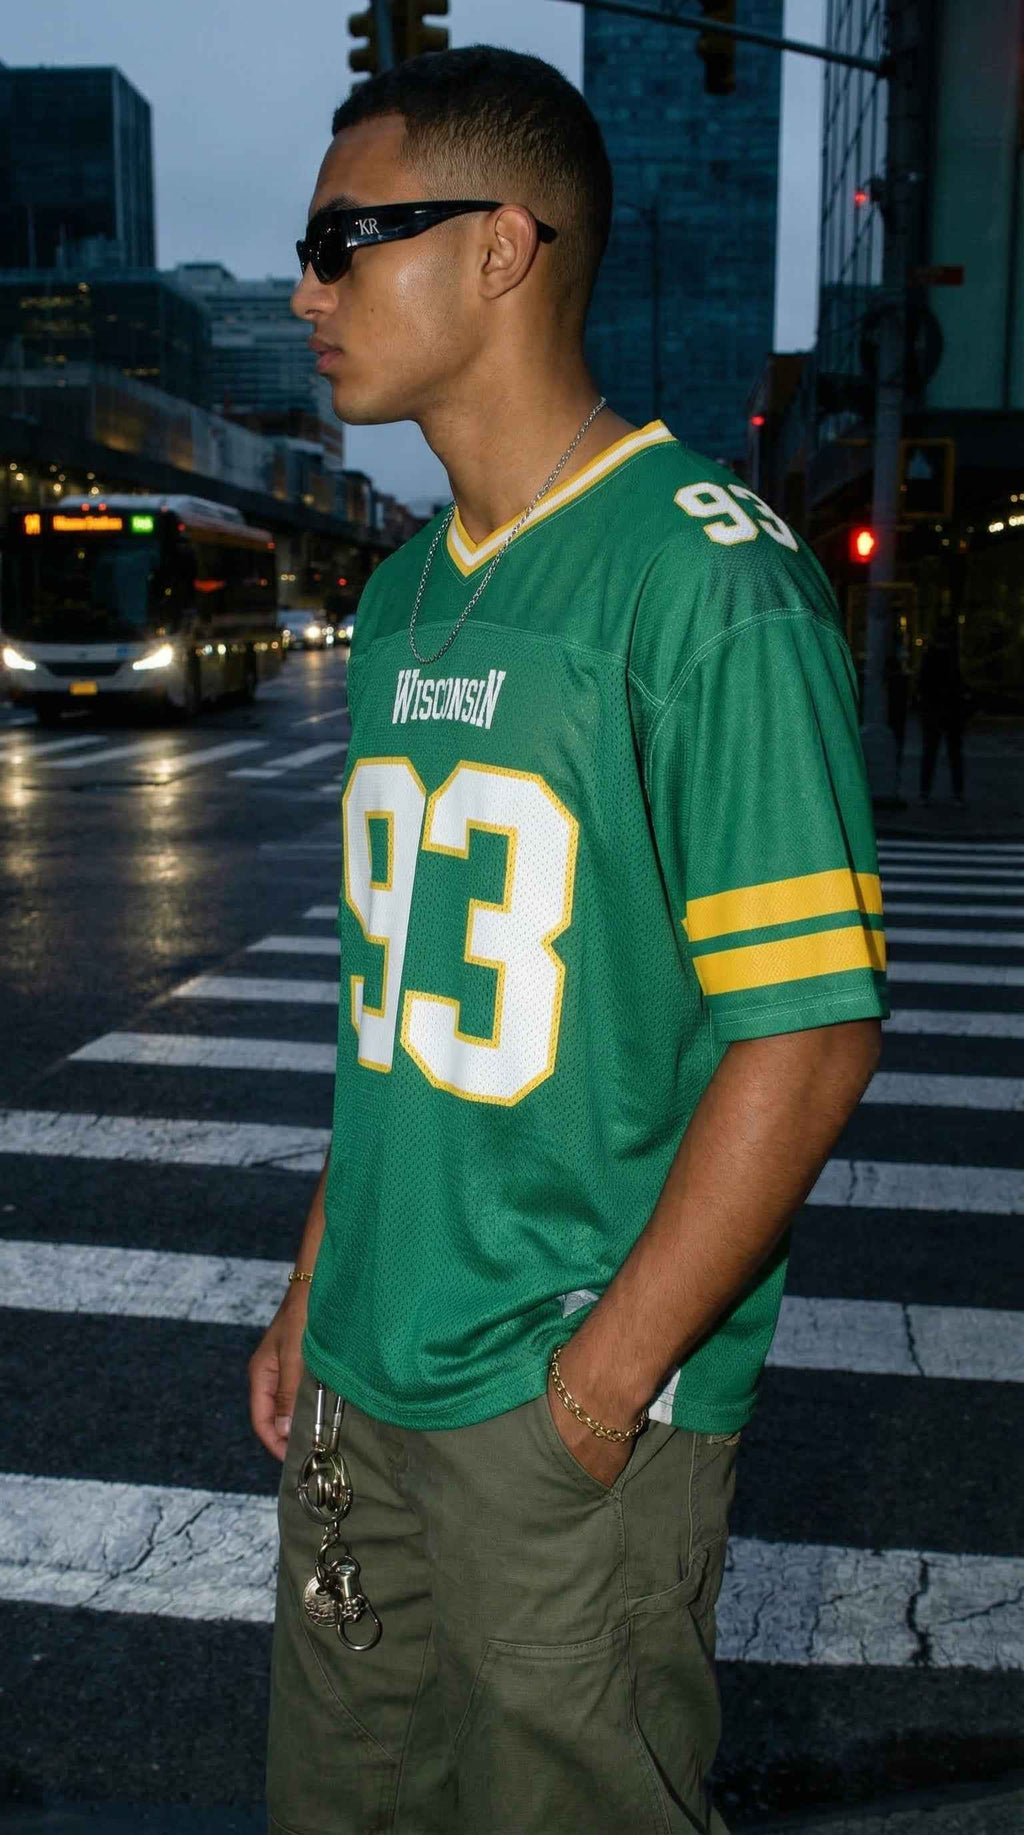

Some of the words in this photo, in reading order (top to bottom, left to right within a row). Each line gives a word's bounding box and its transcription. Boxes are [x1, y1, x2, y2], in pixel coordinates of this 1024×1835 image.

[673, 482, 799, 552] 93
[392, 669, 505, 729] WISCONSIN
[342, 756, 580, 1107] 93
